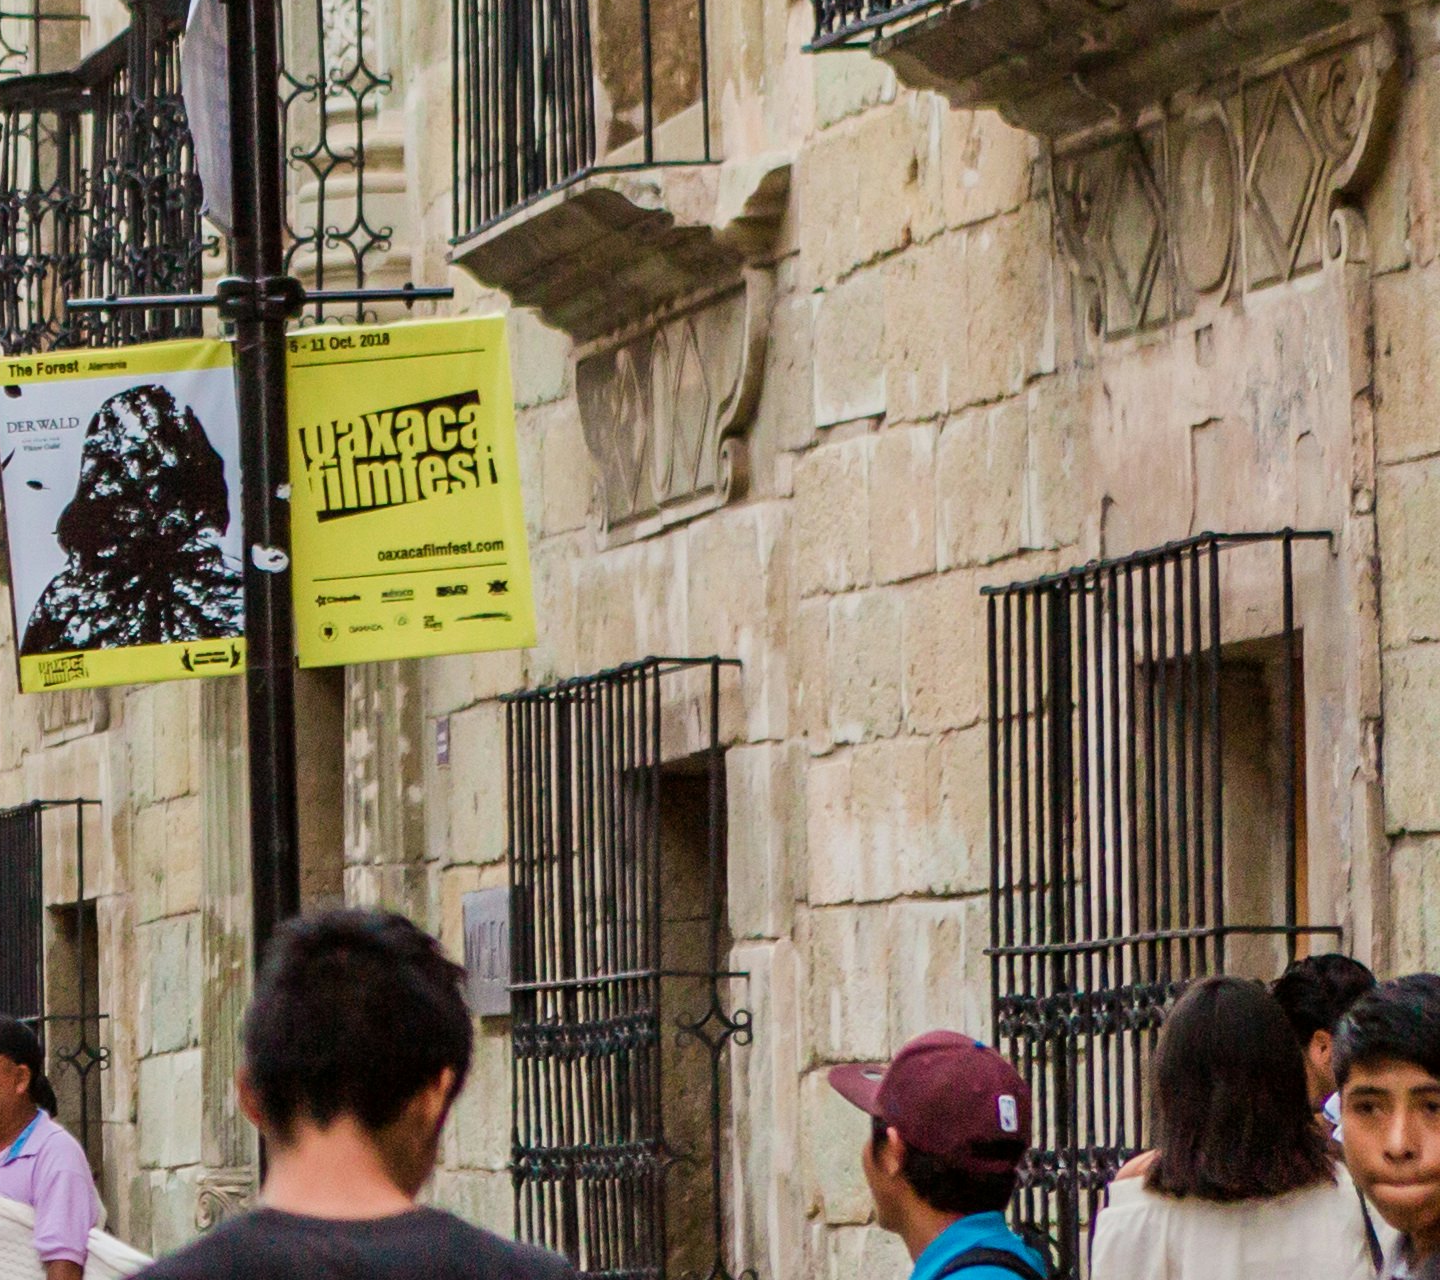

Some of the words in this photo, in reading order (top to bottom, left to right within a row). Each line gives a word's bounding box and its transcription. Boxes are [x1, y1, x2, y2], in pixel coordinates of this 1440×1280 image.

[290, 342, 298, 353] 5
[311, 339, 326, 351] 11
[330, 336, 356, 350] Oct.
[360, 332, 390, 347] 2018
[8, 363, 33, 378] The
[36, 359, 80, 376] Forest
[6, 419, 38, 434] DER
[39, 416, 80, 431] WALD
[299, 400, 481, 464] oaxaca
[306, 445, 499, 510] filmfest
[377, 539, 505, 562] oaxacafilmfest.com
